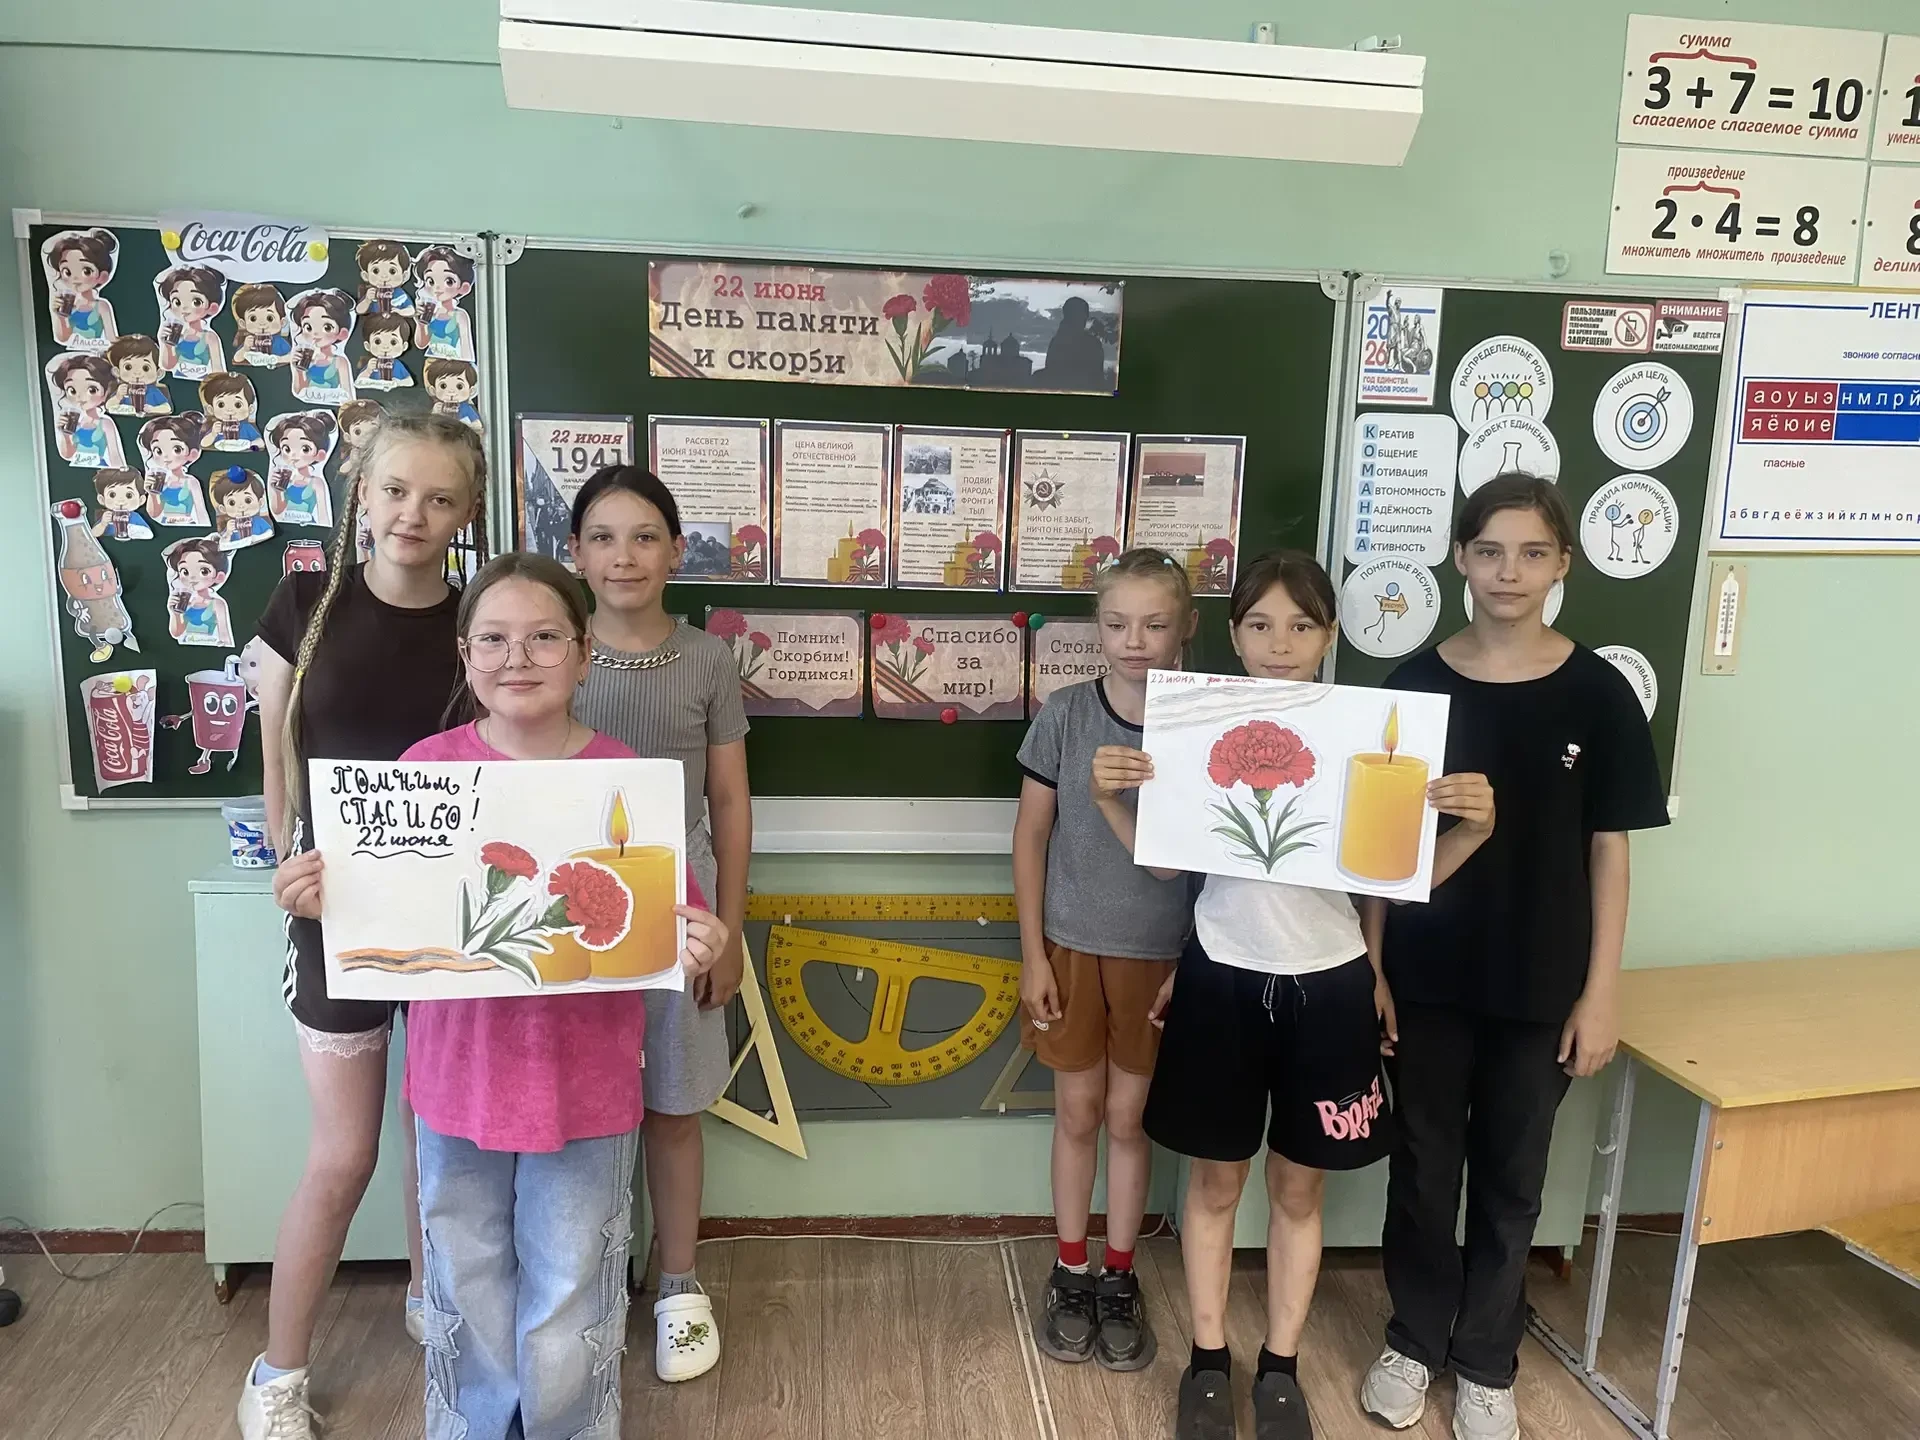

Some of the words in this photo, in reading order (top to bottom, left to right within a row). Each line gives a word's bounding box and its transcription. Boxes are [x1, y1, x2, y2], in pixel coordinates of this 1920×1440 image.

[1679, 33, 1732, 50] сумма
[1644, 66, 1671, 110] 3
[1729, 71, 1756, 115] 7
[1808, 77, 1864, 122] 10
[1632, 114, 1716, 131] слагаемое
[1721, 119, 1803, 136] слагаемое
[1808, 124, 1858, 141] сумма
[1667, 165, 1746, 182] произведение
[1651, 198, 1678, 240] 2
[1715, 202, 1742, 243] 4
[1793, 206, 1820, 247] 8
[1622, 244, 1691, 259] множитель
[1696, 247, 1765, 262] множитель
[1771, 250, 1847, 266] произведение
[713, 275, 744, 298] 22
[753, 280, 826, 302] июня
[658, 300, 745, 331] День
[756, 311, 880, 335] памяти
[1570, 307, 1617, 317] ПОЛЬЗОВАНИЕ
[1660, 305, 1723, 317] ВНИМАНИЕ
[1367, 313, 1390, 340] 20
[72, 337, 109, 348] Алиса
[1567, 336, 1612, 346] ЗАПРЕЩЕНО!
[1655, 343, 1719, 351] ВИДЕОНАБЛЮДЕНИЕ
[693, 347, 714, 367] и
[727, 346, 846, 376] скорби
[1364, 340, 1389, 366] 26
[1842, 351, 1879, 359] звонкие
[1460, 343, 1533, 387] РАСПРЕДЕЛЕННЫЕ
[1531, 359, 1546, 386] РОЛИ
[1363, 376, 1375, 384] ГОД
[1611, 370, 1644, 395] ОБЩАЯ
[1645, 370, 1669, 385] ЦЕЛЬ
[1362, 385, 1391, 393] НАРОДОВ
[550, 429, 571, 444] 22
[574, 433, 624, 445] июня
[685, 437, 718, 445] РАССВЕТ
[720, 438, 729, 446] 22
[1473, 420, 1508, 449] ЭФФЕКТ
[1510, 419, 1551, 453] ЕДИНЕНИЯ
[662, 447, 686, 455] ИЮНЯ
[688, 448, 706, 456] 1941
[708, 449, 730, 457] ГОДА
[795, 441, 816, 449] ЦЕНА
[817, 442, 854, 450] ВЕЛИКОЙ
[551, 446, 623, 473] 1941
[792, 451, 856, 461] ОТЕЧЕСТВЕННОЙ
[1763, 459, 1805, 468] гласные
[963, 476, 994, 484] ПОДВИГ
[961, 497, 987, 505] ФРОНТ
[1589, 485, 1620, 524] ПРАВИЛА
[1621, 481, 1672, 533] КОММУНИКАЦИИ
[969, 507, 985, 515] ТЫЛ
[1026, 515, 1052, 523] НИКТО
[1360, 560, 1412, 580] ПОНЯТНЫЕ
[1411, 567, 1433, 608] РЕСУРСЫ
[777, 630, 845, 646] Помним!
[921, 626, 1018, 645] Спасибо
[772, 648, 850, 664] Скорбим!
[956, 656, 983, 670] за
[768, 666, 854, 683] Гордимся!
[1039, 663, 1113, 677] насмер
[1603, 652, 1618, 661] АЯ
[1619, 653, 1652, 699] МОТИВАЦИЯ
[1150, 673, 1163, 684] 22
[942, 678, 995, 698] мир!
[357, 825, 387, 847] 22
[390, 833, 454, 847] июня
